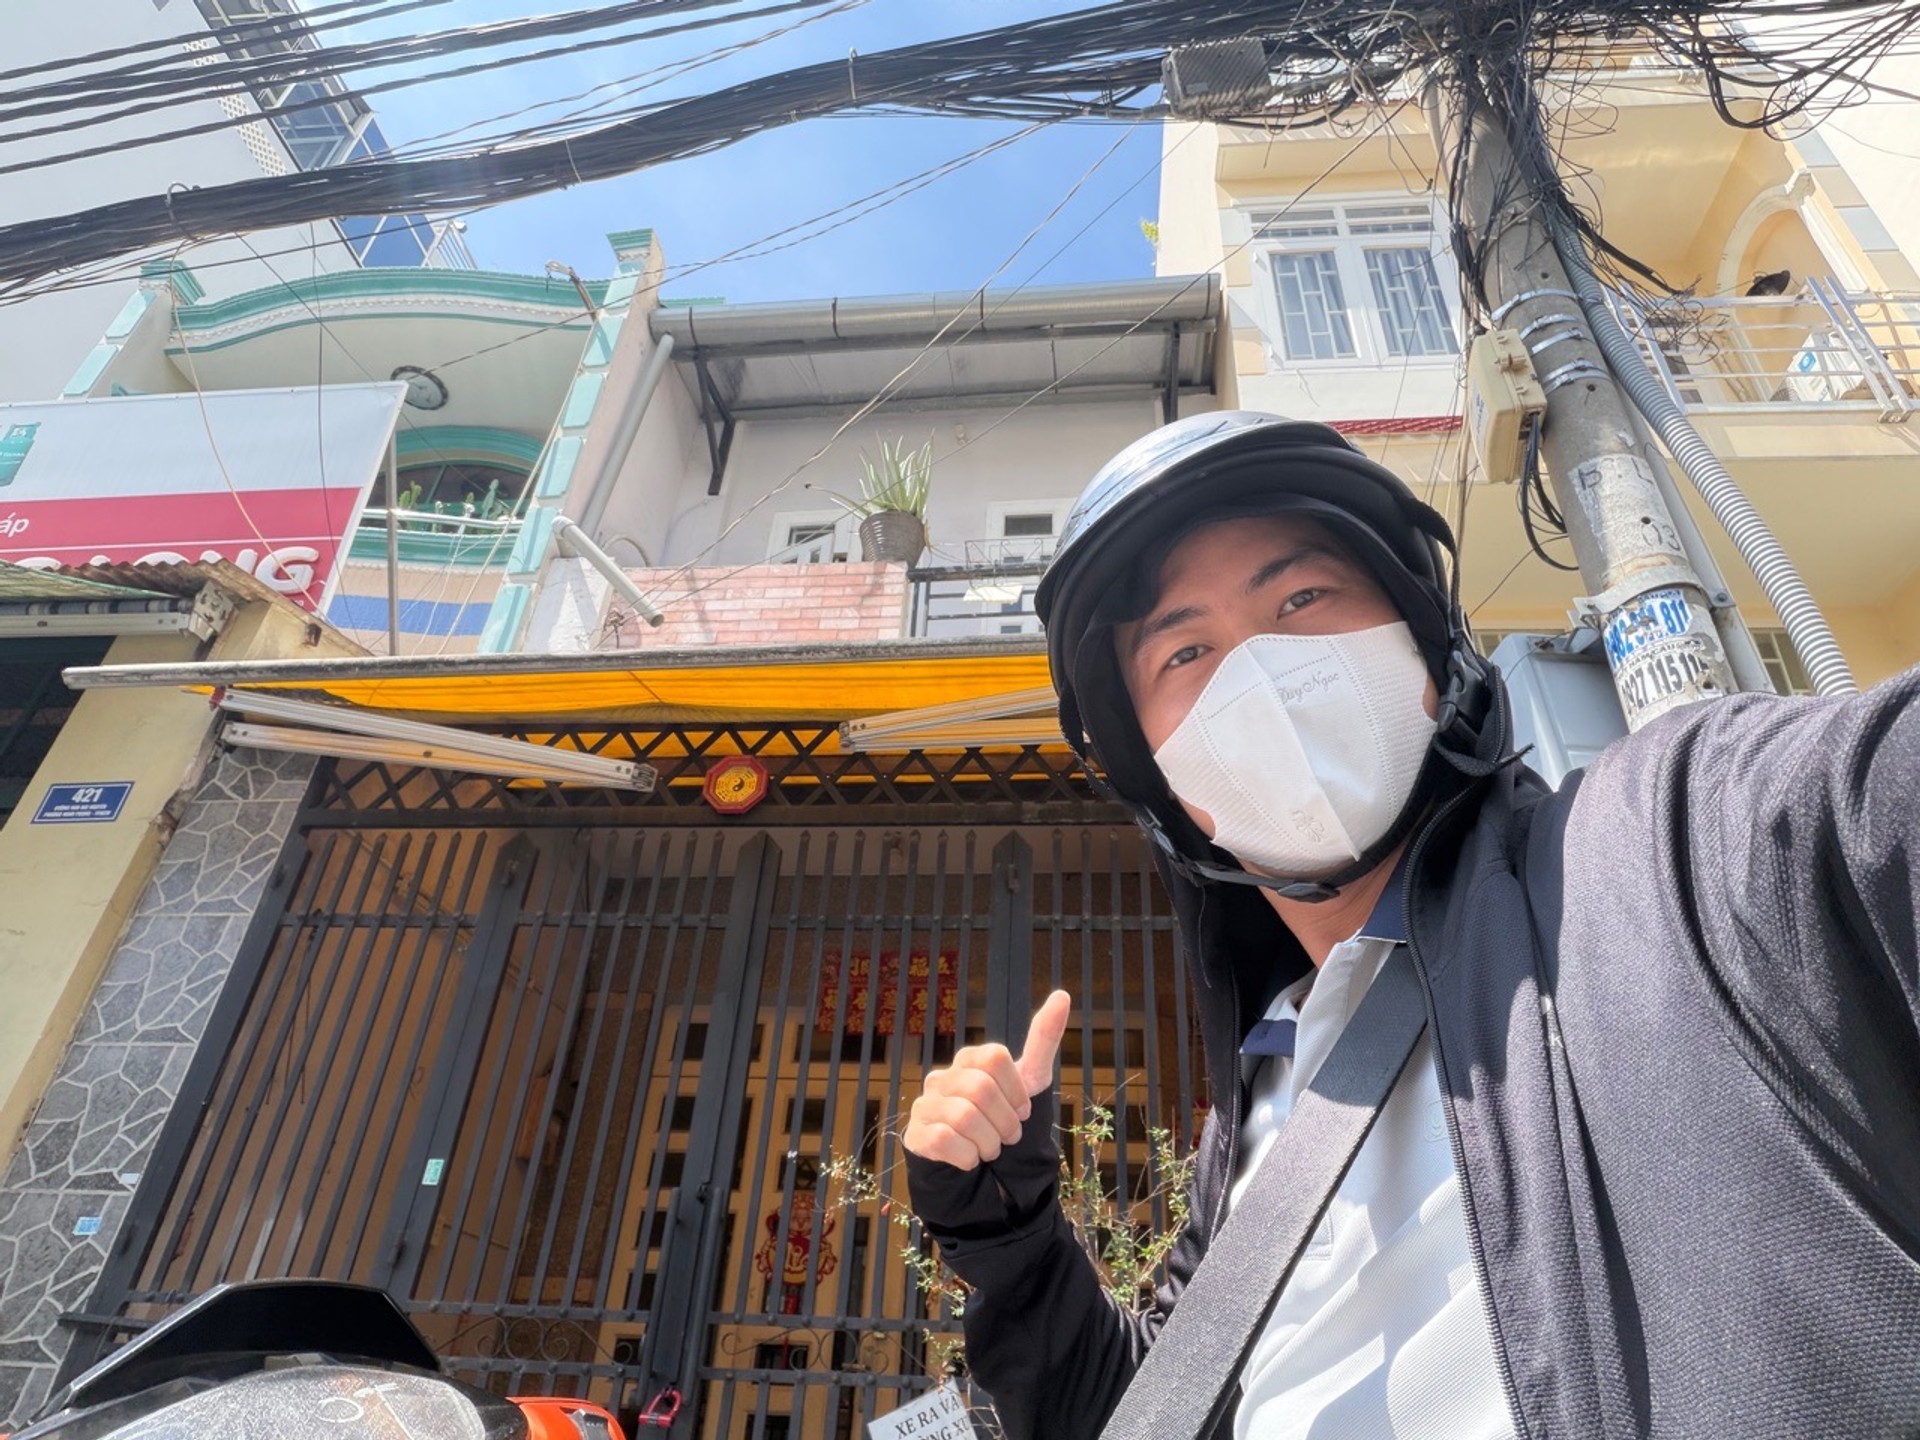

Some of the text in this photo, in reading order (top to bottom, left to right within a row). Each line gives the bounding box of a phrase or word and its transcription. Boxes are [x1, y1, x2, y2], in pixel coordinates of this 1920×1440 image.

[72, 787, 104, 802] 421
[895, 1418, 917, 1440] XE
[917, 1406, 939, 1428] RA
